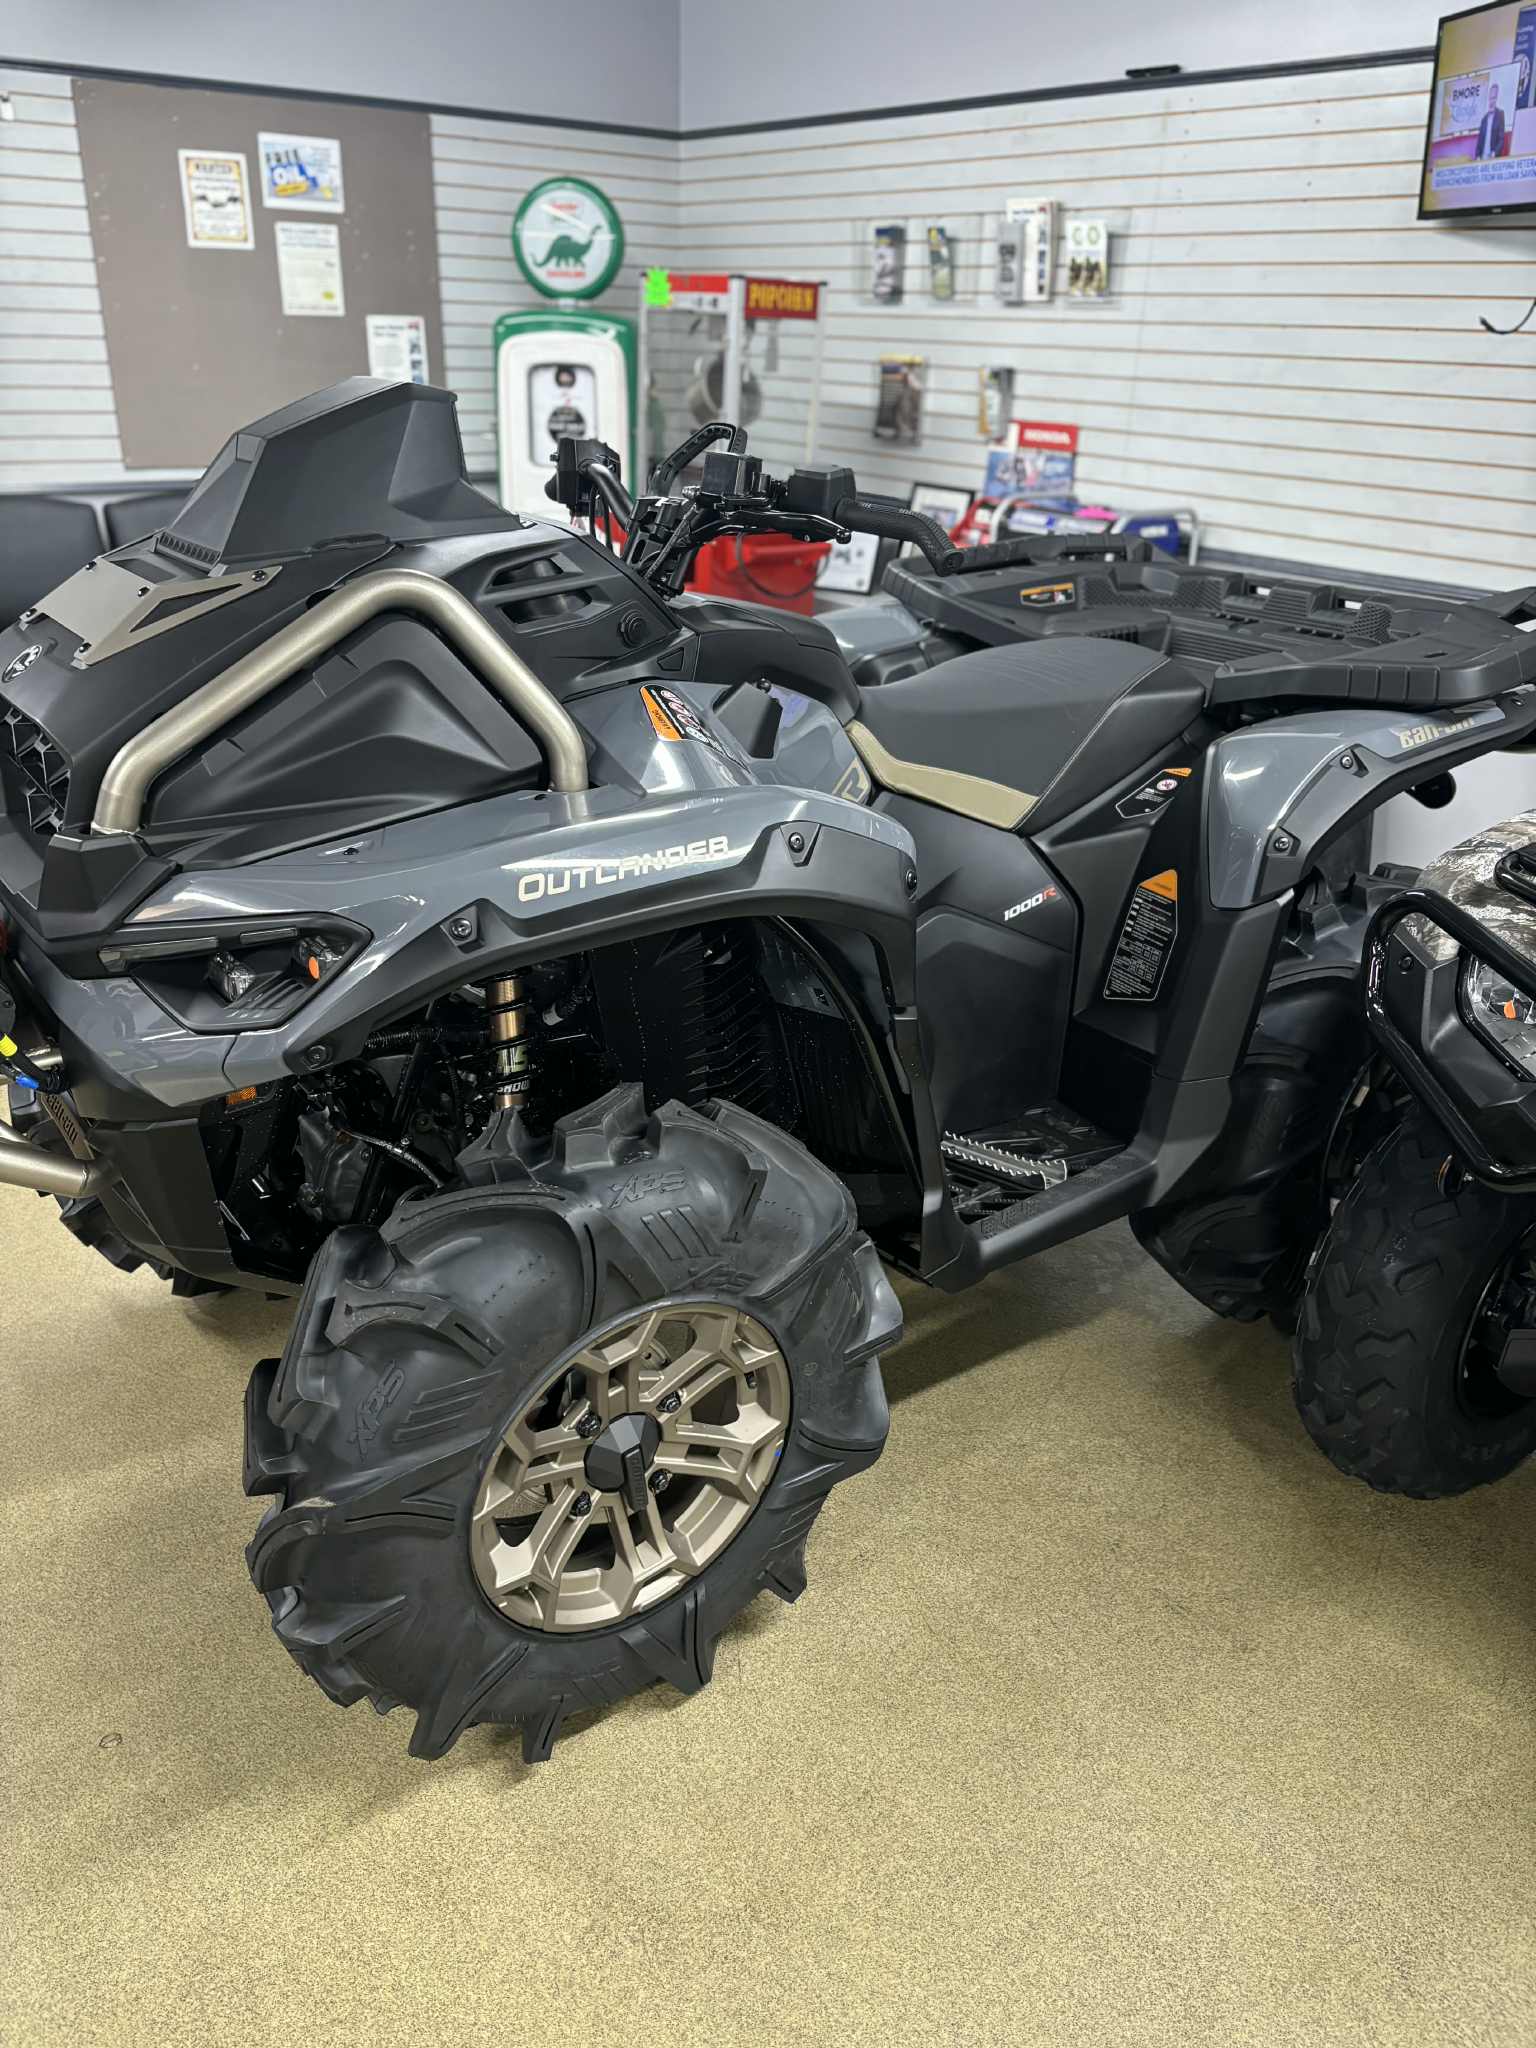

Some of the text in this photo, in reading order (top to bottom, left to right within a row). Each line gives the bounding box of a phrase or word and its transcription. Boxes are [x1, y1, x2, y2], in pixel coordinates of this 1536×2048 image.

[750, 282, 814, 311] POPCORN
[518, 835, 729, 902] OUTLANDER
[1004, 886, 1057, 921] 1000R
[608, 1167, 688, 1209] XPS
